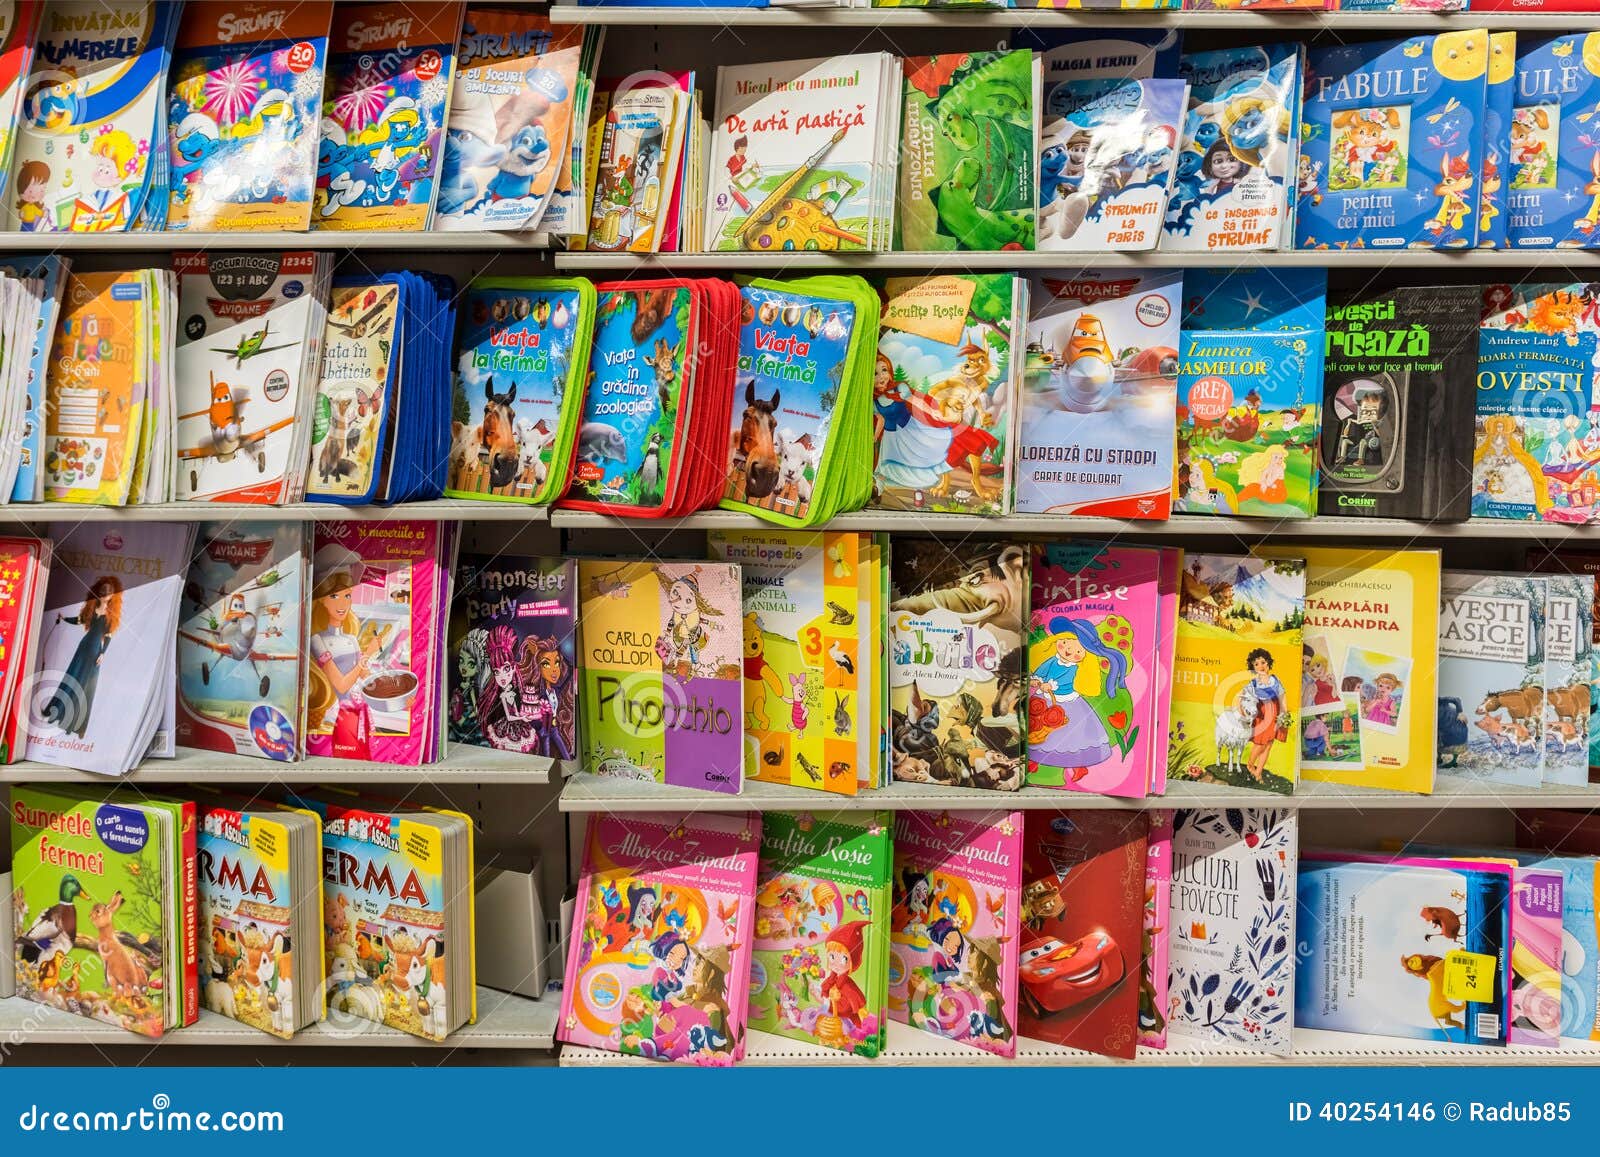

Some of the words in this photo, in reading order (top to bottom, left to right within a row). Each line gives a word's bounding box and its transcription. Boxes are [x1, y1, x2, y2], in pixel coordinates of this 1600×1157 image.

[1050, 57, 1093, 72] MAGIA
[1095, 55, 1138, 69] IERNII
[735, 77, 772, 97] Micul
[776, 78, 806, 92] meu
[809, 69, 860, 91] manual
[1317, 66, 1430, 103] FABULE
[1518, 66, 1579, 98] ULE
[725, 114, 748, 136] De
[752, 110, 789, 133] artă
[795, 104, 867, 135] plastică
[907, 101, 922, 202] DINOZAURII
[922, 123, 936, 177] PITICI
[1342, 194, 1393, 212] pentru
[1336, 214, 1360, 230] cei
[1362, 210, 1396, 229] mici
[174, 257, 206, 266] ABCDE
[209, 256, 247, 273] JOCURI
[247, 256, 280, 272] LOGICE
[282, 256, 314, 267] 12345
[216, 275, 233, 285] 123
[249, 275, 269, 285] ABC
[1059, 284, 1121, 297] AVIOANE
[218, 304, 262, 315] AVIOANE
[932, 303, 965, 321] Roșie
[1349, 321, 1364, 332] de
[352, 341, 368, 358] în
[489, 327, 541, 356] Viața
[753, 327, 810, 364] Viața
[1187, 341, 1253, 358] Lumea
[1488, 335, 1530, 346] Andrew
[1533, 336, 1560, 347] Lang
[470, 347, 490, 369] la
[491, 348, 549, 373] fermă
[603, 348, 637, 367] Viața
[1518, 351, 1586, 371] FERMECATĂ
[626, 365, 640, 380] în
[755, 353, 818, 385] fermă
[1339, 363, 1356, 373] care
[1358, 362, 1368, 372] le
[1368, 363, 1382, 372] vor
[1384, 363, 1401, 374] face
[1414, 362, 1444, 373] tremuri
[601, 379, 649, 397] grădina
[1476, 371, 1585, 397] OVEȘTI
[595, 397, 655, 417] zoologică
[1191, 402, 1226, 416] SPECIAL
[1506, 405, 1516, 413] de
[1021, 443, 1081, 463] LOREAZĂ
[1084, 448, 1103, 463] CU
[1107, 449, 1158, 465] STROPI
[1034, 470, 1063, 482] CARTE
[1065, 471, 1078, 483] DE
[1079, 471, 1123, 485] COLORAT
[742, 535, 766, 545] Prima
[769, 536, 788, 546] mea
[214, 545, 258, 558] AVIOANE
[726, 545, 803, 562] Enciclopedie
[744, 576, 785, 587] ANIMALE
[750, 601, 797, 613] ANIMALE
[1051, 604, 1082, 613] COLORAT
[926, 626, 959, 634] frumoase
[1303, 616, 1401, 632] ALEXANDRA
[605, 630, 652, 648] CARLO
[805, 626, 822, 656] 3
[592, 648, 653, 667] COLLODI
[1200, 654, 1222, 666] Spyri
[596, 675, 733, 736] Pinocchio
[45, 736, 58, 746] de
[58, 739, 95, 753] colorat
[14, 800, 93, 839] Sunetele
[104, 815, 121, 826] carte
[39, 835, 105, 877] fermei
[821, 836, 874, 868] Roșie
[186, 856, 195, 907] fermei
[1181, 885, 1240, 920] POVESTE
[186, 908, 196, 965] Sunetele
[1465, 973, 1477, 990] 24
